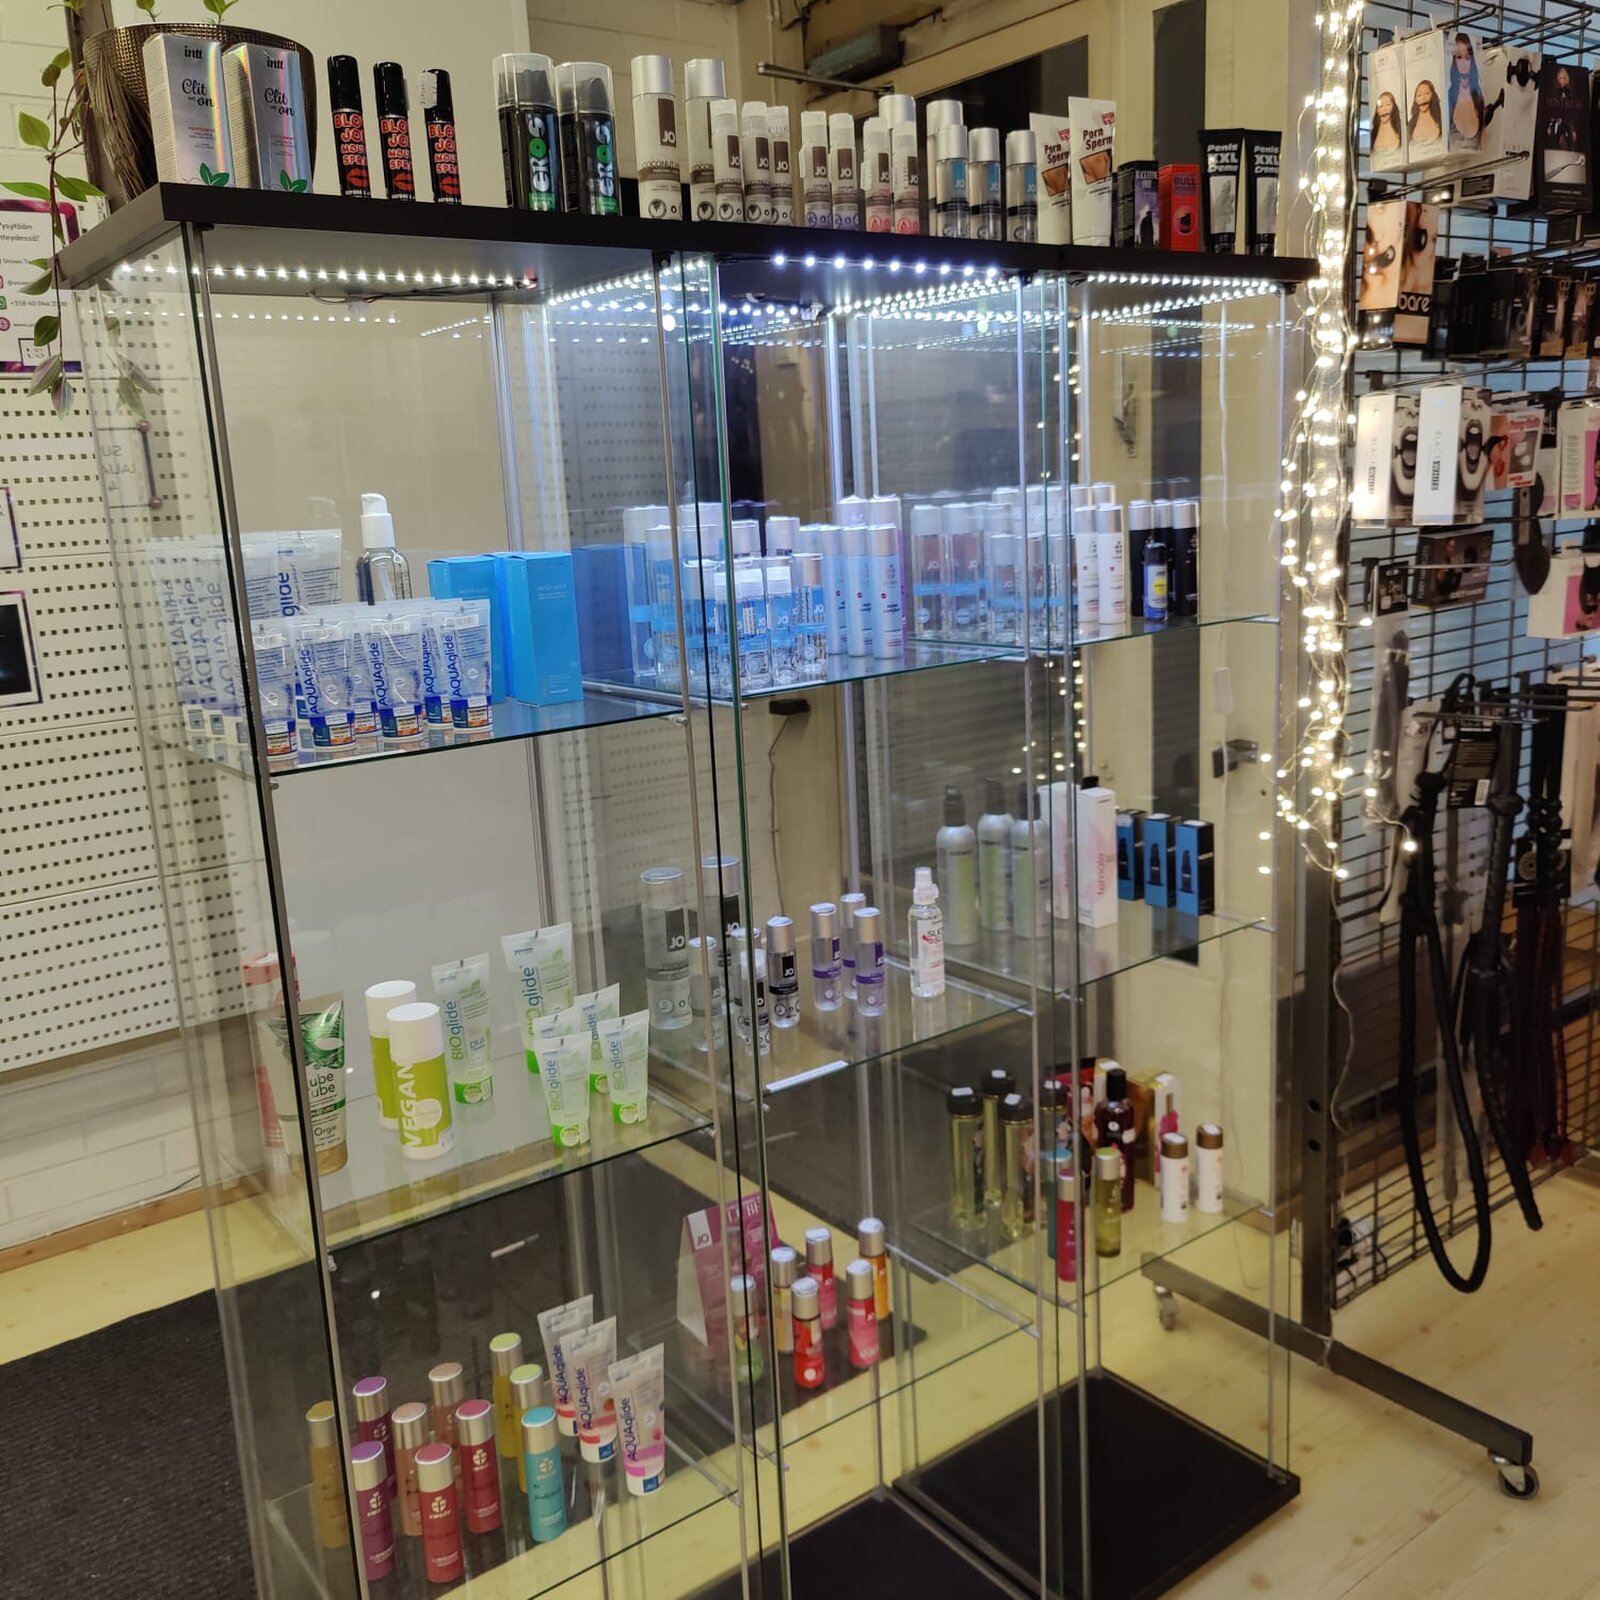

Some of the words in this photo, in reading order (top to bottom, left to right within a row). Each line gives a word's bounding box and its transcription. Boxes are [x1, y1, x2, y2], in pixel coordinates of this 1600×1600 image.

[182, 78, 207, 96] Clit
[197, 96, 214, 108] on
[264, 87, 288, 105] Clit
[278, 105, 295, 117] on
[334, 113, 362, 128] BLO
[381, 119, 408, 133] BLO
[341, 128, 364, 143] JO
[428, 124, 455, 138] BLO
[662, 130, 676, 144] JO
[1082, 128, 1104, 141] Porn
[388, 134, 408, 147] JO
[435, 138, 456, 152] JO
[1086, 136, 1112, 150] Sperm
[341, 143, 365, 154] MOU
[388, 148, 409, 158] MOU
[1044, 143, 1062, 154] Porn
[1207, 144, 1238, 152] Penis
[1254, 146, 1279, 154] Penis
[342, 155, 367, 166] SPR
[435, 154, 456, 162] MOU
[730, 155, 740, 165] JO
[758, 156, 769, 168] JO
[1207, 152, 1238, 163] XXL
[1254, 154, 1279, 165] XXL
[389, 159, 411, 170] SPR
[436, 163, 458, 174] SPR
[777, 160, 788, 171] JO
[815, 166, 826, 176] JO
[840, 168, 852, 178] JO
[955, 180, 964, 188] JO
[990, 183, 998, 191] JO
[1027, 184, 1036, 192] JO
[278, 572, 299, 617] glide
[814, 604, 824, 614] JO
[776, 614, 789, 624] JO
[445, 634, 462, 698] AQUAglide
[369, 642, 388, 707] AQUAglide
[298, 649, 320, 715] AQUAglide
[669, 935, 685, 950] JO
[784, 968, 794, 977] JO
[446, 1001, 463, 1060] BIOglide
[610, 1038, 624, 1092] BIOglide
[310, 1072, 335, 1088] ube
[545, 1059, 562, 1111] BIOglide
[311, 1084, 336, 1098] ube
[398, 1062, 423, 1149] VEGAN
[697, 1234, 710, 1246] JO
[576, 1367, 592, 1430] AQUAglide
[621, 1397, 638, 1462] AQUAglide
